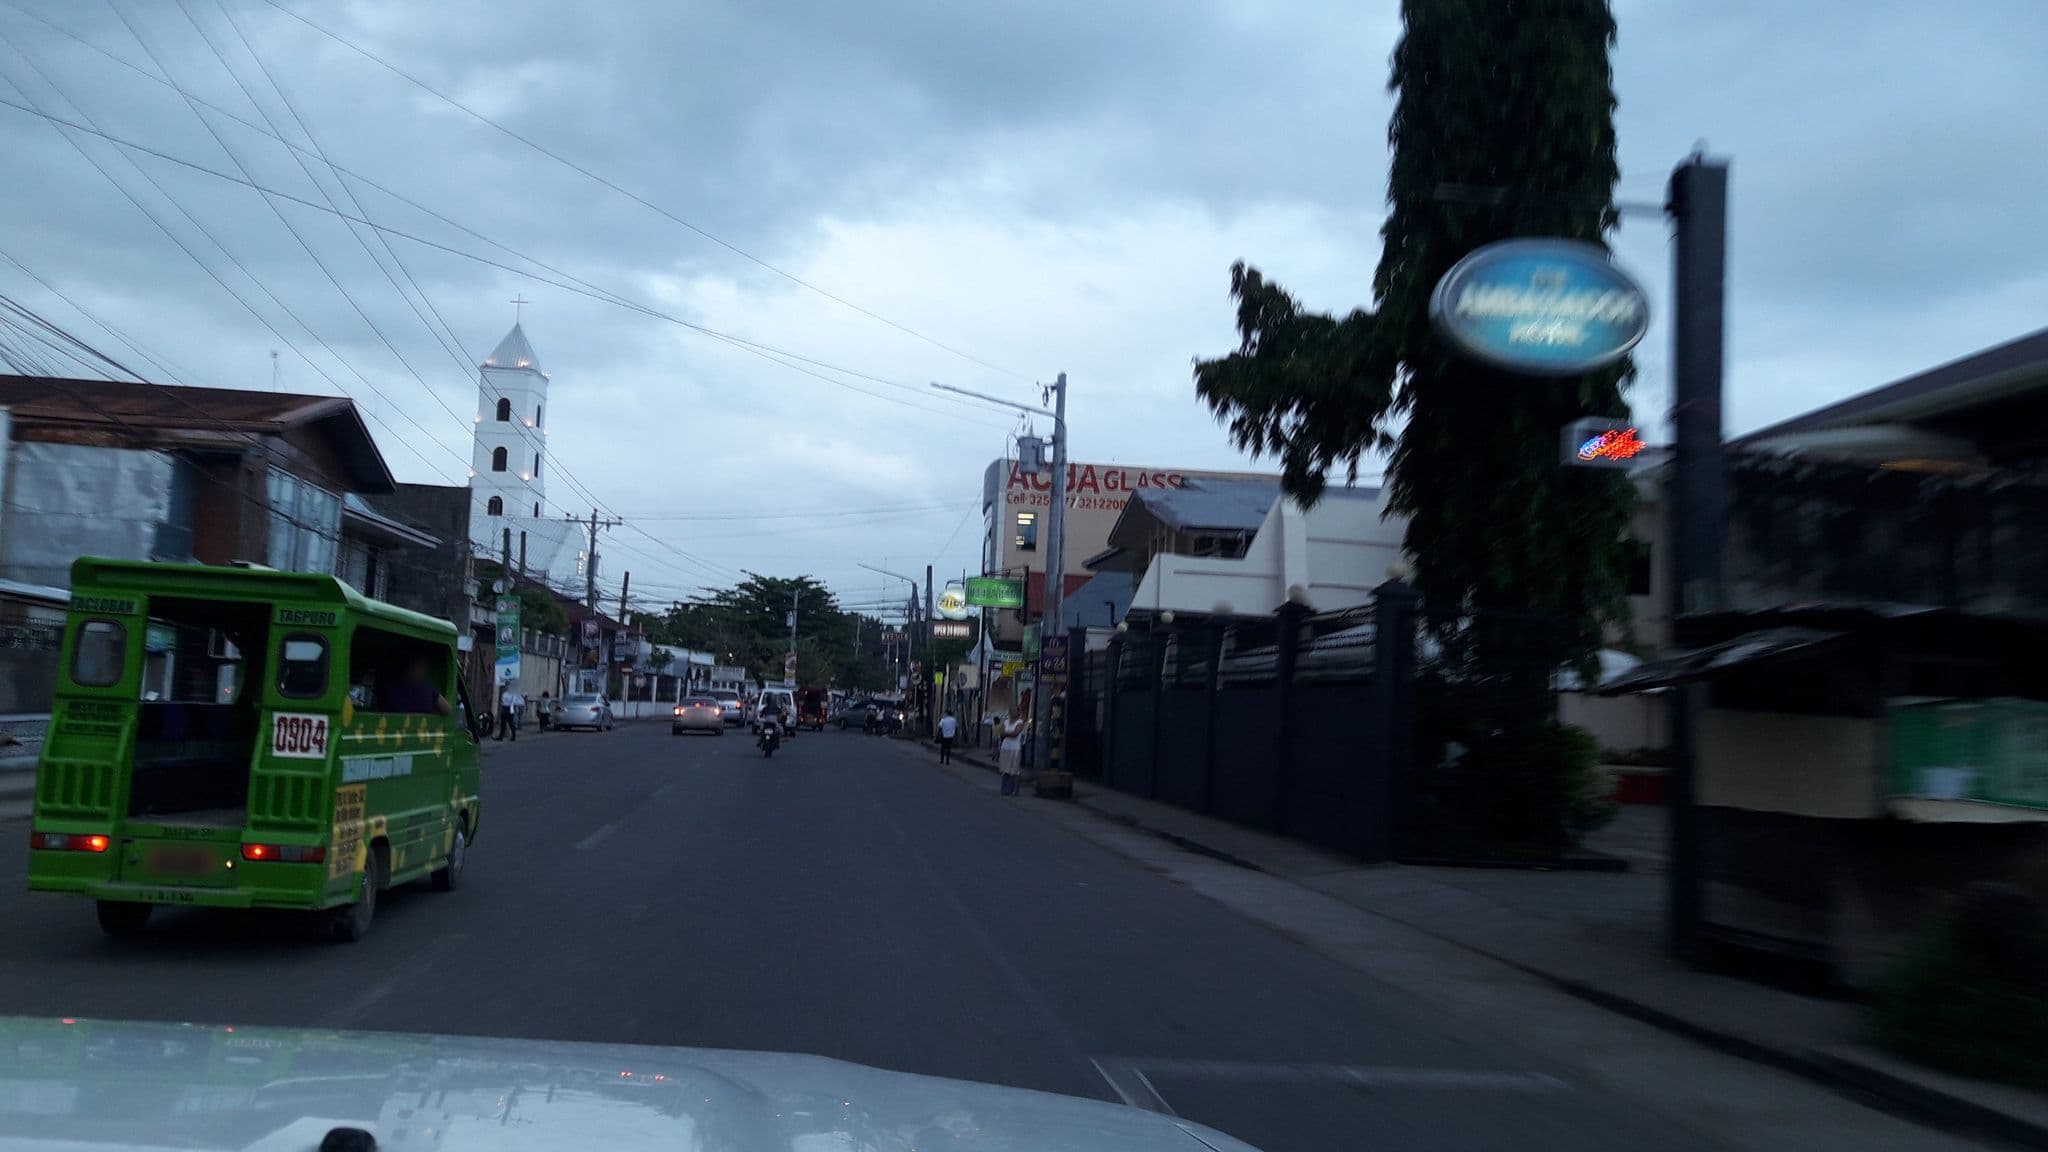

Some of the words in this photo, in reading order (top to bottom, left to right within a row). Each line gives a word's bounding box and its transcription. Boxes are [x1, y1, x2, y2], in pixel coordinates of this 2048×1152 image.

[1103, 470, 1183, 491] GLASS
[279, 609, 336, 624] TAGPURO
[275, 715, 326, 754] 0904
